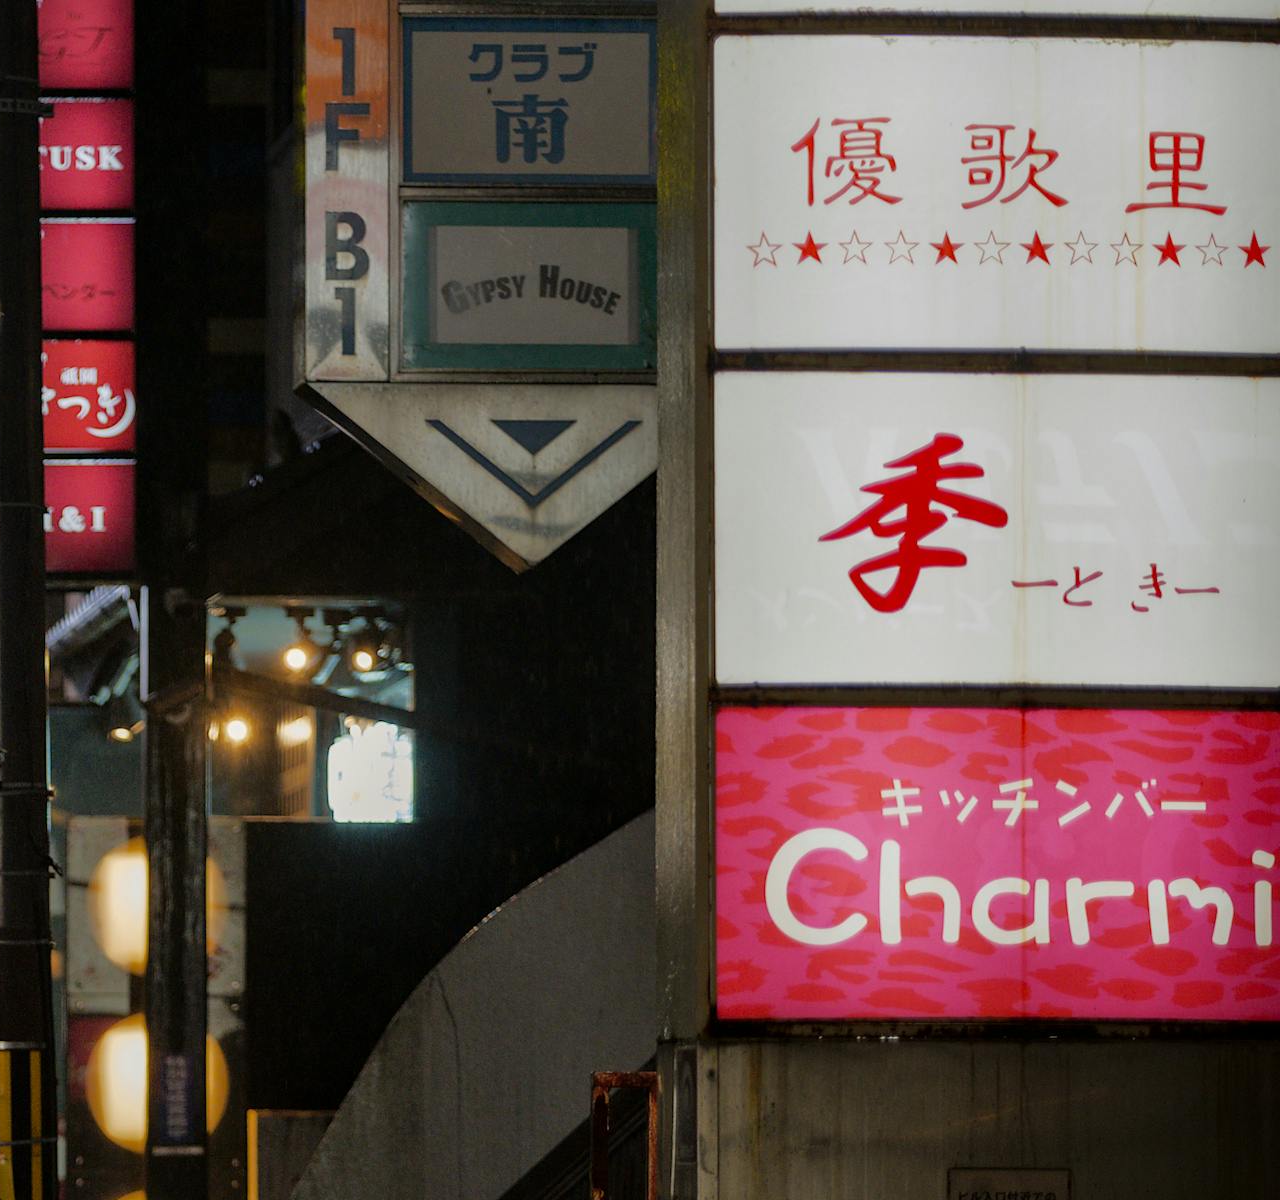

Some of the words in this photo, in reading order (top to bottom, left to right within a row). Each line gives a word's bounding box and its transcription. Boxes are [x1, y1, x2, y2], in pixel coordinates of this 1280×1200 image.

[467, 42, 598, 83] クラブ
[491, 93, 570, 165] 南
[790, 116, 1229, 217] 優歌里
[441, 275, 527, 315] GYPSY
[539, 264, 622, 316] HOUSE
[818, 432, 1009, 613] 季
[880, 777, 1207, 827] キッチンバー
[765, 827, 1277, 947] Charmi
